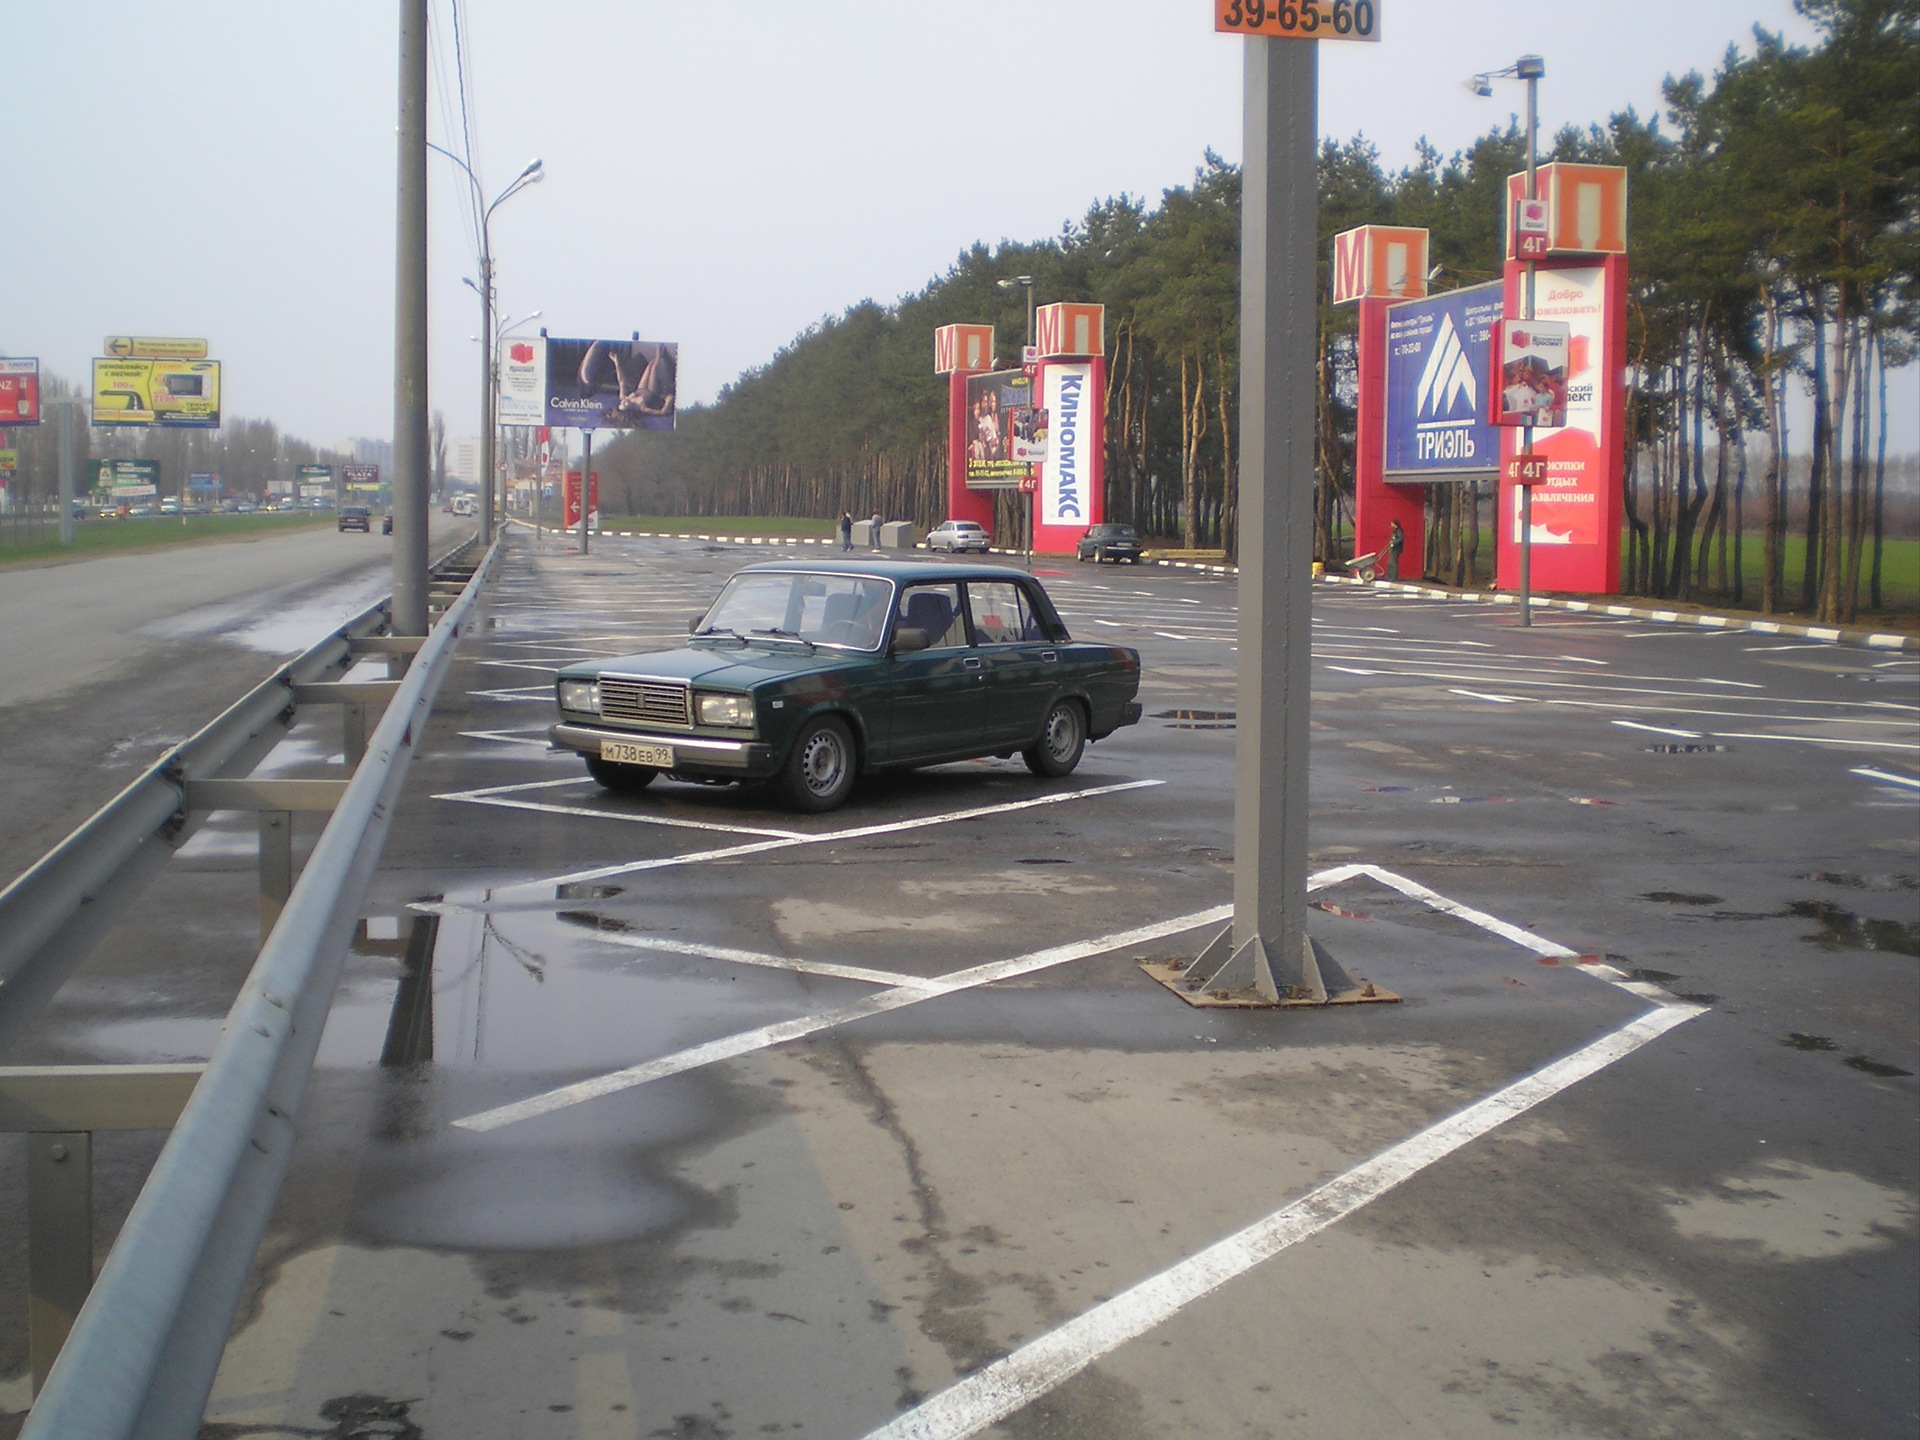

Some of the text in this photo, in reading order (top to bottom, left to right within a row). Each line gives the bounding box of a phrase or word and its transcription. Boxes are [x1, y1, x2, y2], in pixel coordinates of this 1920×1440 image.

[1224, 0, 1374, 36] 39-65-60
[1523, 237, 1545, 252] 4Г
[1548, 289, 1584, 301] Добро
[1536, 304, 1602, 316] ожаловать!
[550, 396, 580, 409] Calvin
[580, 398, 603, 410] Klein
[1058, 374, 1083, 518] КИНОМАКС
[1416, 429, 1475, 459] ТРИЭЛЬ
[1523, 461, 1545, 478] 4Г
[1531, 492, 1595, 503] АЗВЛЕЧЕНИЯ
